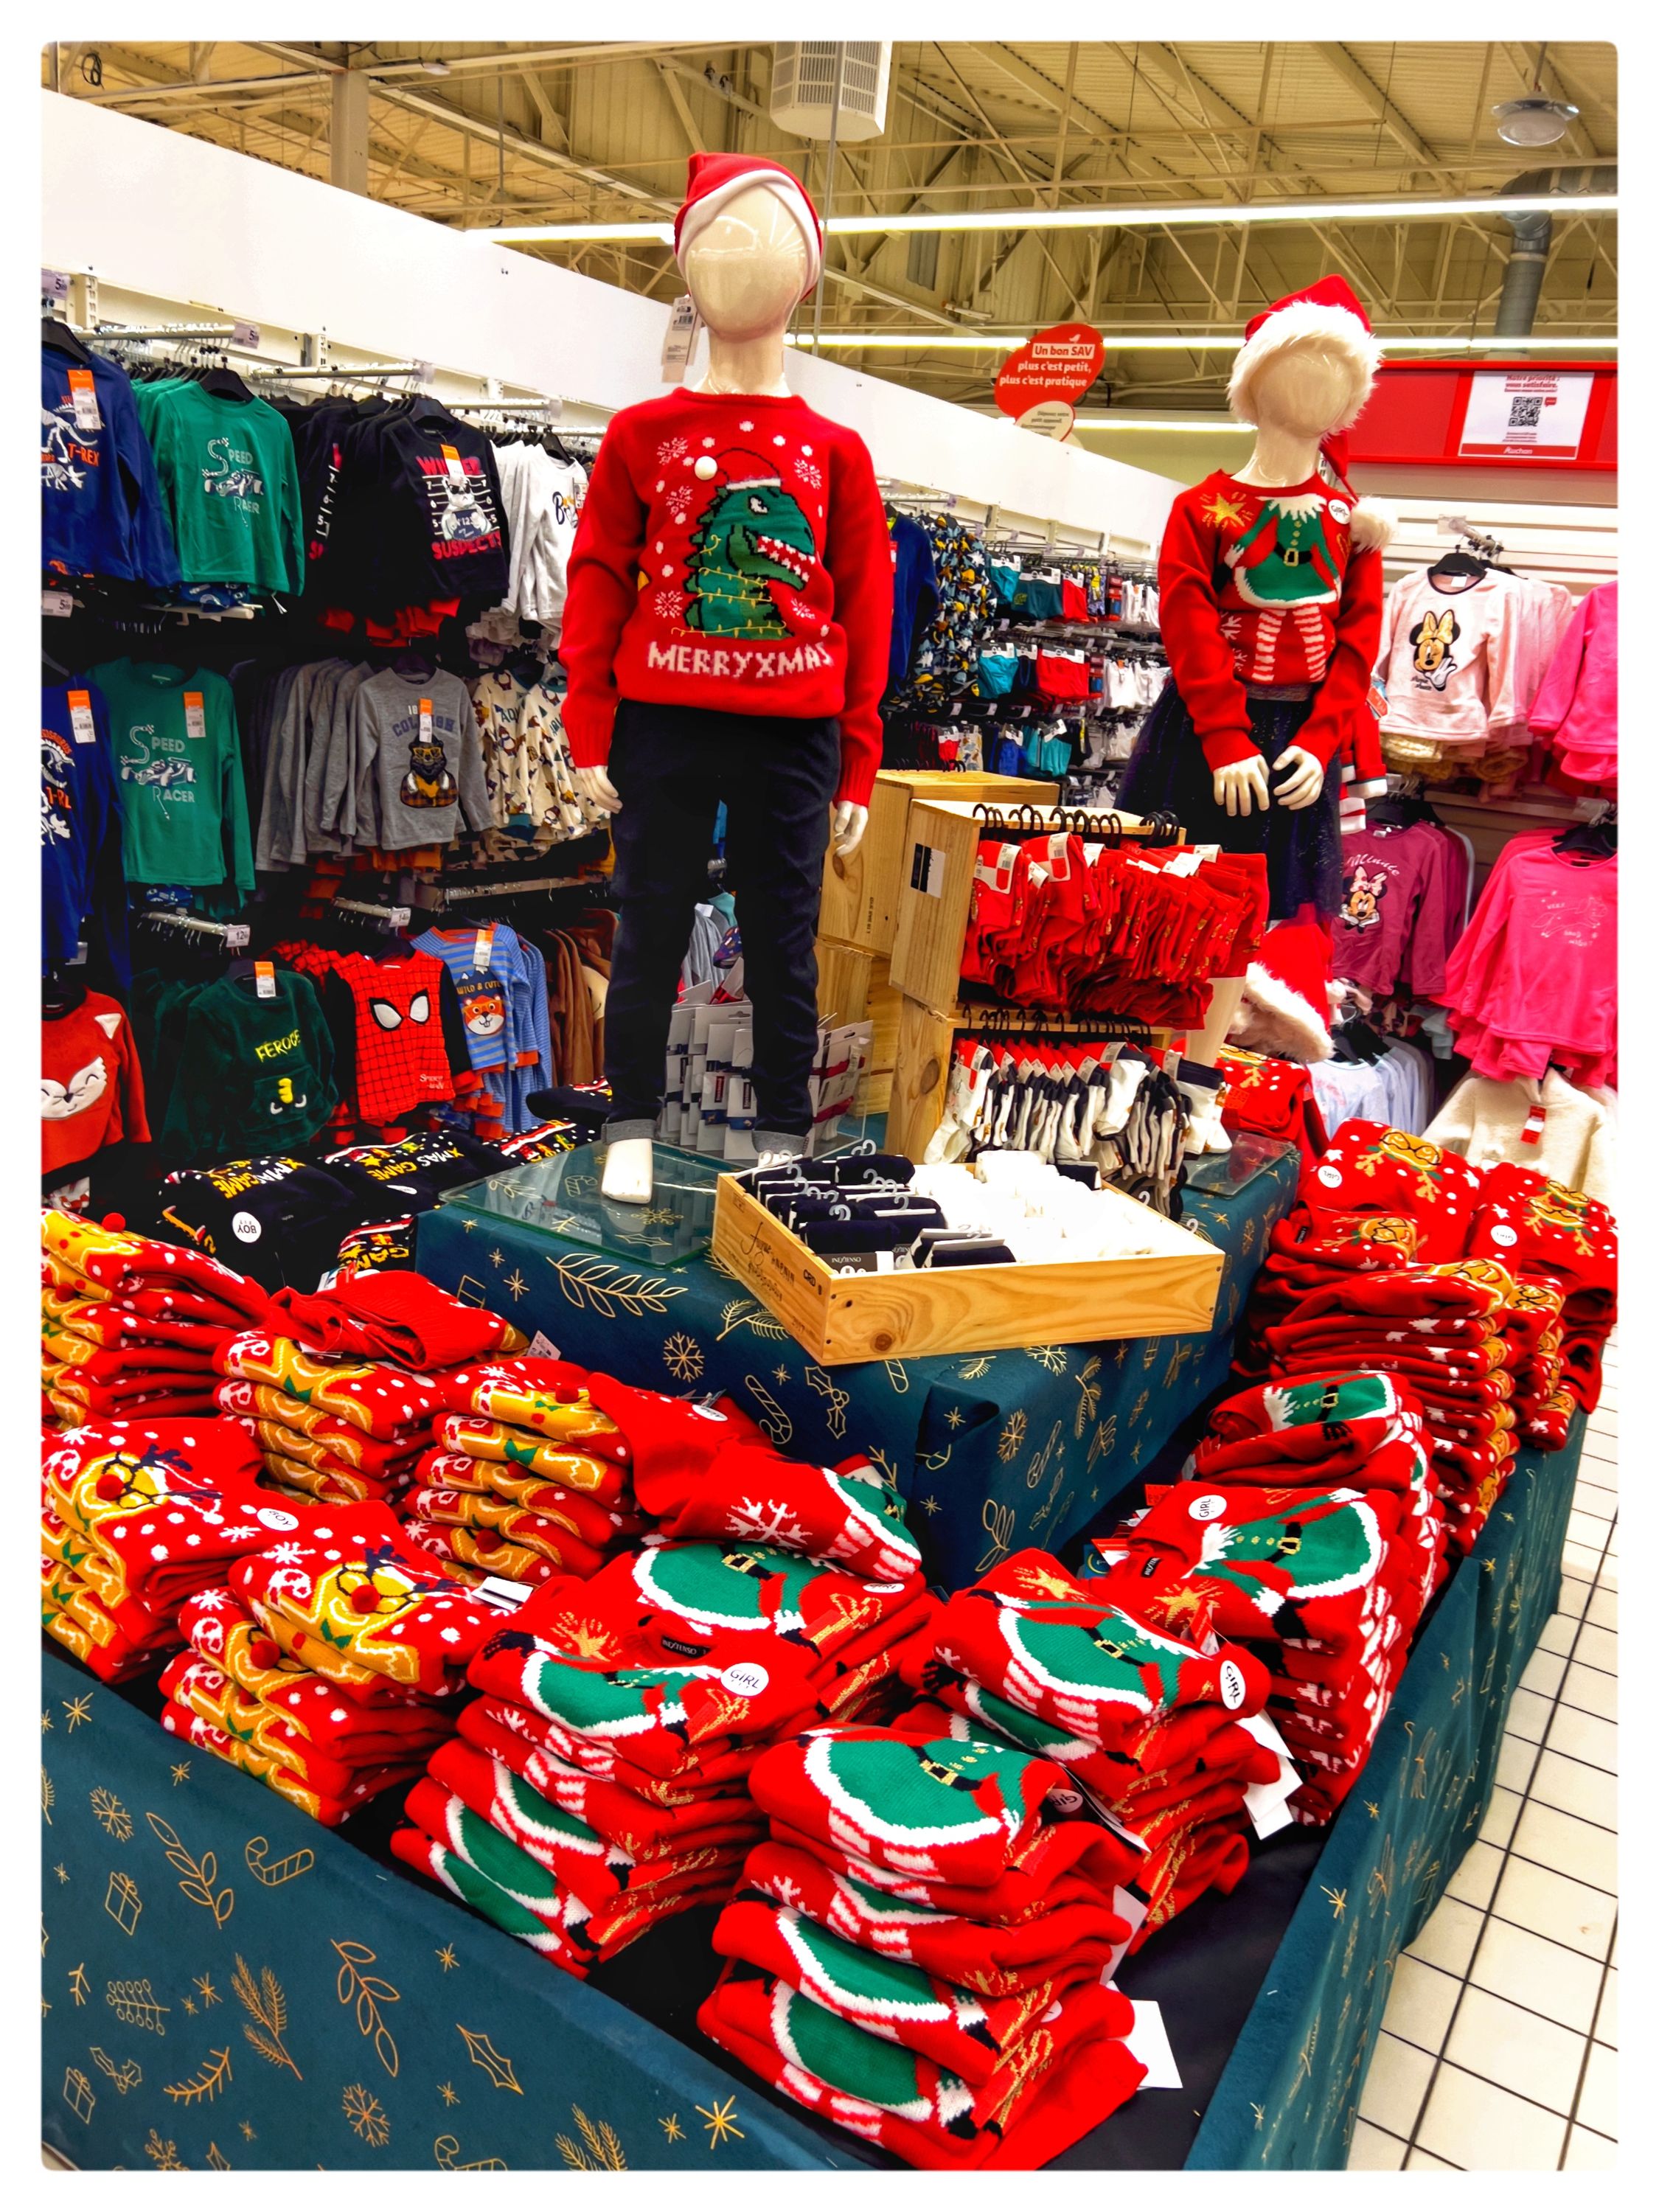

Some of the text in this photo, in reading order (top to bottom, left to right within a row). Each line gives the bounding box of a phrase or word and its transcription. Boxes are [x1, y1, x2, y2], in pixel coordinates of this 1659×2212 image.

[1035, 345, 1093, 356] Un bon SAV
[1018, 361, 1091, 374] plus c'est petit,
[999, 375, 1088, 389] plus c'est pratique
[68, 443, 100, 466] T-REX
[202, 437, 254, 478] SPEED
[120, 724, 185, 765] SPEED
[456, 984, 476, 995] WILD
[255, 1029, 301, 1062] FEROCE
[417, 1147, 465, 1166] XMAS
[366, 1162, 417, 1180] GAME
[212, 1172, 260, 1199] GAME
[237, 1225, 257, 1234] BOY
[1199, 1498, 1211, 1517] GIRL
[730, 1669, 761, 1689] GIRL
[1227, 1666, 1240, 1704] GIRL
[1050, 1795, 1077, 1806] GIR
